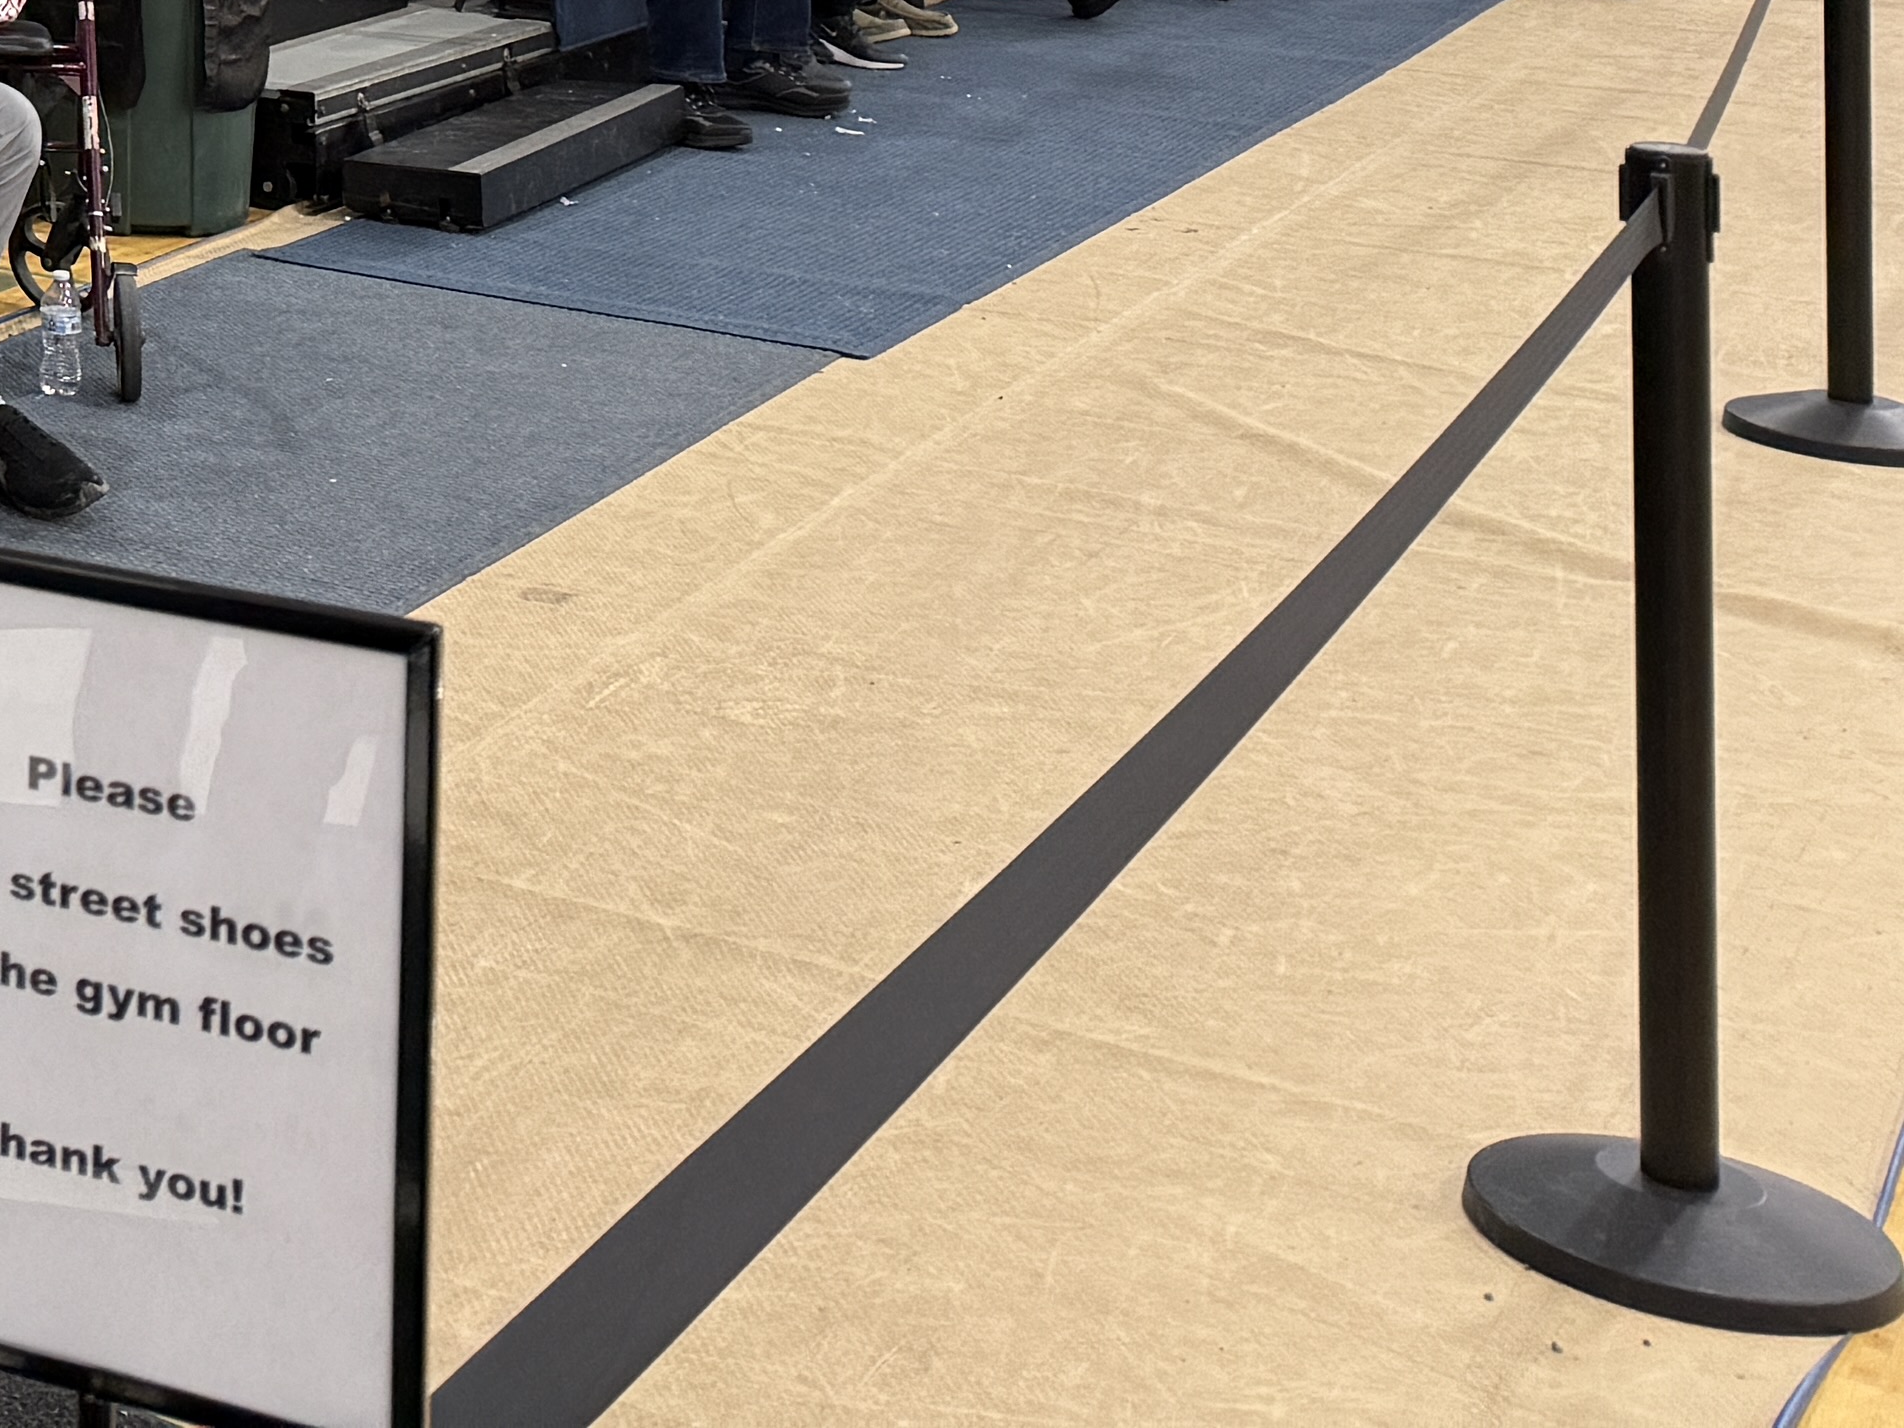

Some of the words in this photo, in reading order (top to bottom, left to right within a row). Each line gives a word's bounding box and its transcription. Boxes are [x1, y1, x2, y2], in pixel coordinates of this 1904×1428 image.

[28, 755, 197, 822] Please
[8, 868, 163, 930] street
[179, 904, 336, 967] shoes
[75, 974, 182, 1026] gym
[198, 996, 322, 1056] floor
[139, 1158, 247, 1215] you!
